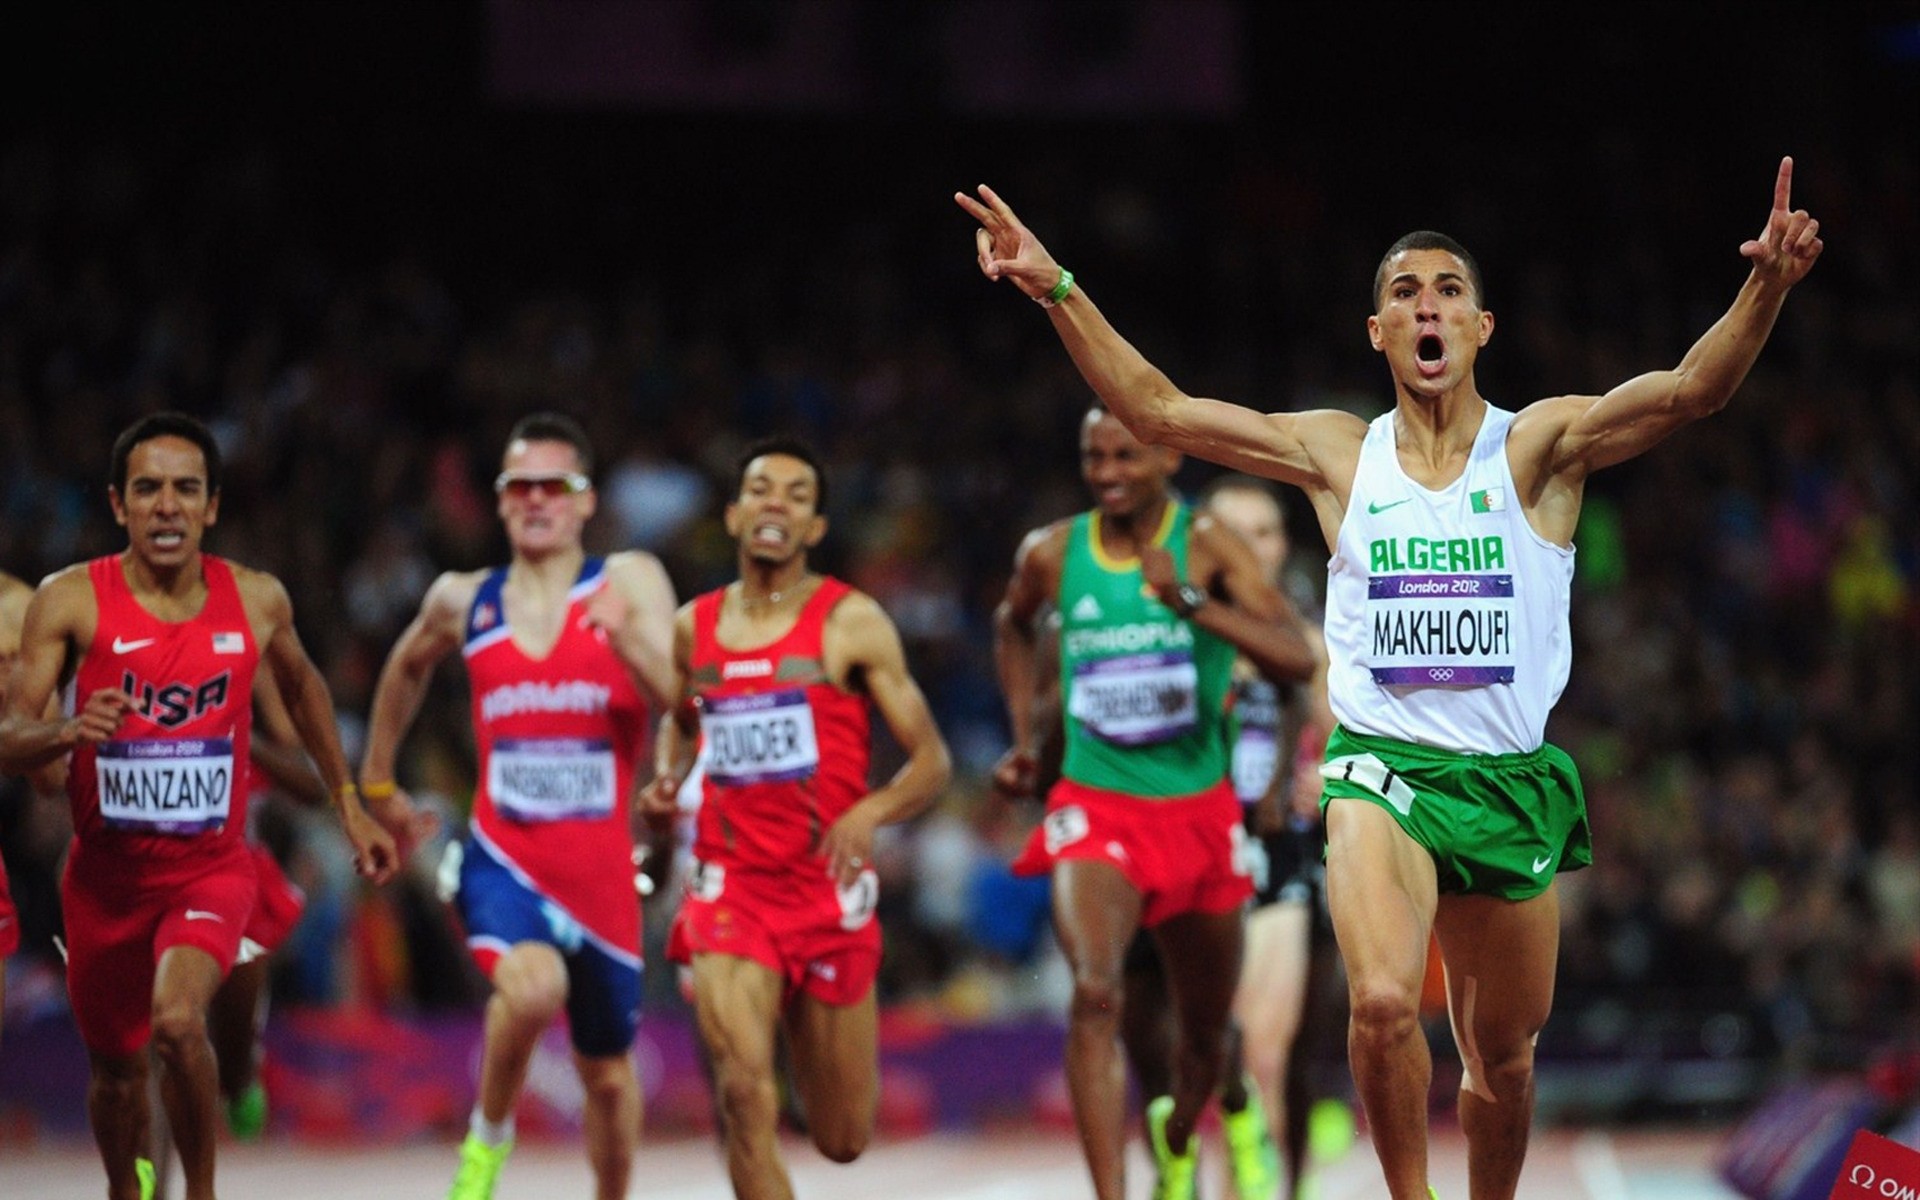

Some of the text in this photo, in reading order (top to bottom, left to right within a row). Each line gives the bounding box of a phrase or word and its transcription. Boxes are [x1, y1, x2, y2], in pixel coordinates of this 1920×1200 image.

[1370, 536, 1504, 572] ALGERIA
[1399, 579, 1480, 594] London 2012
[1373, 609, 1510, 656] MAKHLOUFI
[122, 668, 232, 731] USA
[104, 767, 227, 808] MANZANO
[1880, 1178, 1920, 1200] OM
